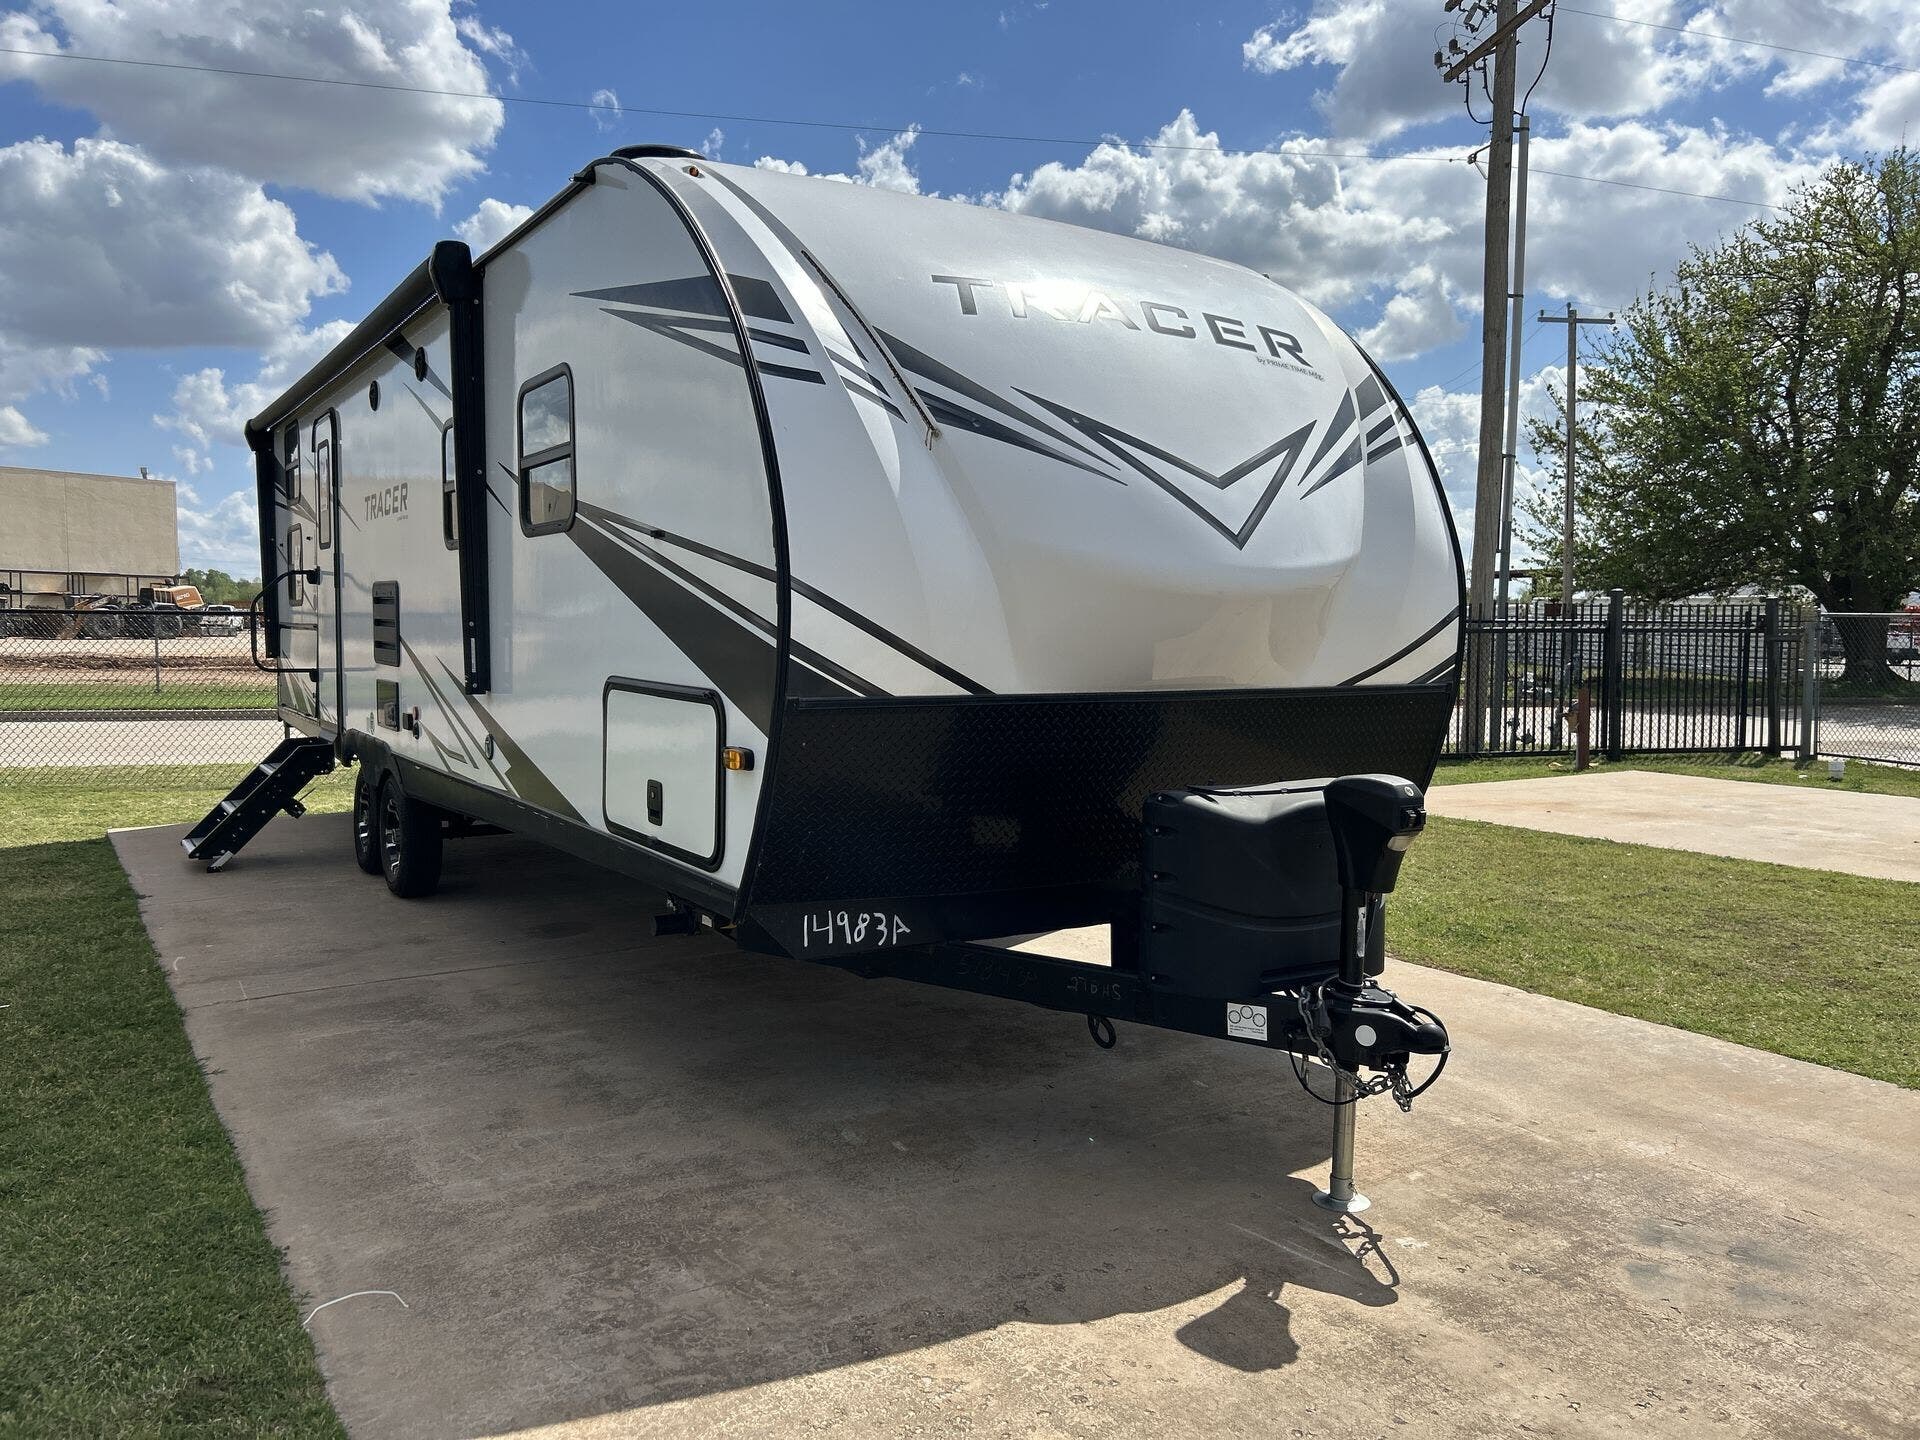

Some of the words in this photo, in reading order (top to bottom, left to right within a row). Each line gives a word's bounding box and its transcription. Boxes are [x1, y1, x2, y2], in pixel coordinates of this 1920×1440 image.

[931, 274, 1314, 368] TRACER
[364, 482, 409, 522] TRACER
[803, 910, 912, 948] 14983A
